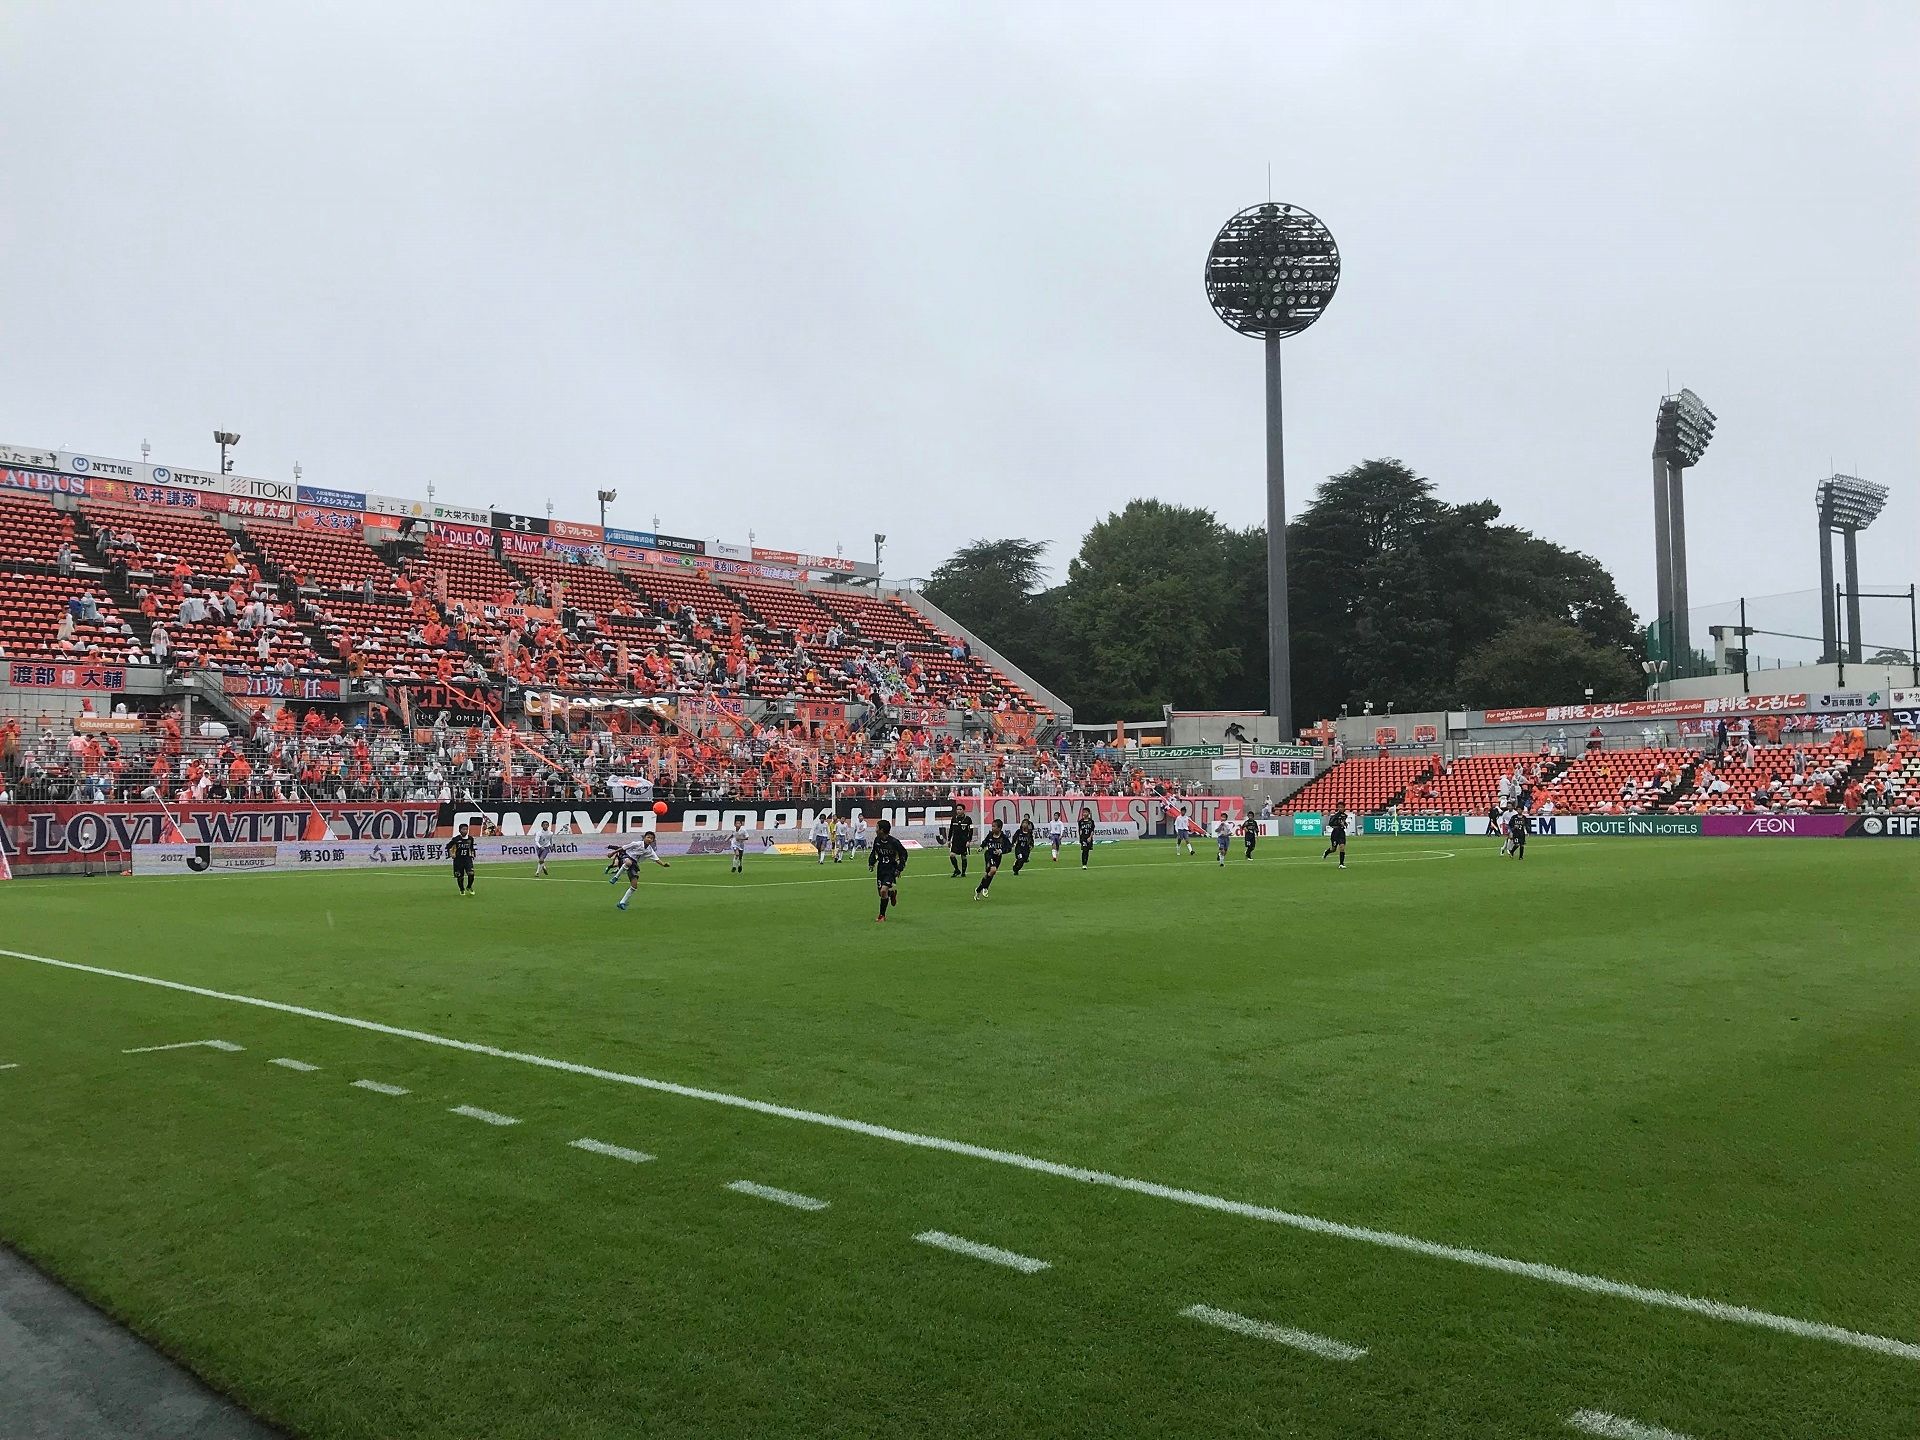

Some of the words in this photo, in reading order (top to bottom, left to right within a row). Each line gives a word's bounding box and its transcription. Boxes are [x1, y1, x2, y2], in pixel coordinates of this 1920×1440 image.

[250, 481, 292, 500] ITOKI
[228, 498, 291, 519] 清水慎太郎
[444, 509, 488, 523] 大栄不動産
[13, 665, 57, 685] 渡部
[81, 669, 123, 688] 大輔
[1703, 694, 1807, 713] 勝利を、ともに。
[456, 714, 483, 722] OMIY
[1270, 761, 1310, 776] 朝日新聞
[337, 809, 439, 840] YOU
[1374, 818, 1453, 832] 明治安田生命
[1582, 821, 1626, 834] ROUTE
[1656, 824, 1698, 834] HOTELS
[762, 836, 775, 847] VS
[299, 849, 345, 863] 第30節
[391, 844, 456, 862] 武蔵野
[501, 843, 535, 855] Presen
[161, 854, 183, 862] 2017
[234, 859, 266, 867] LEAGUE
